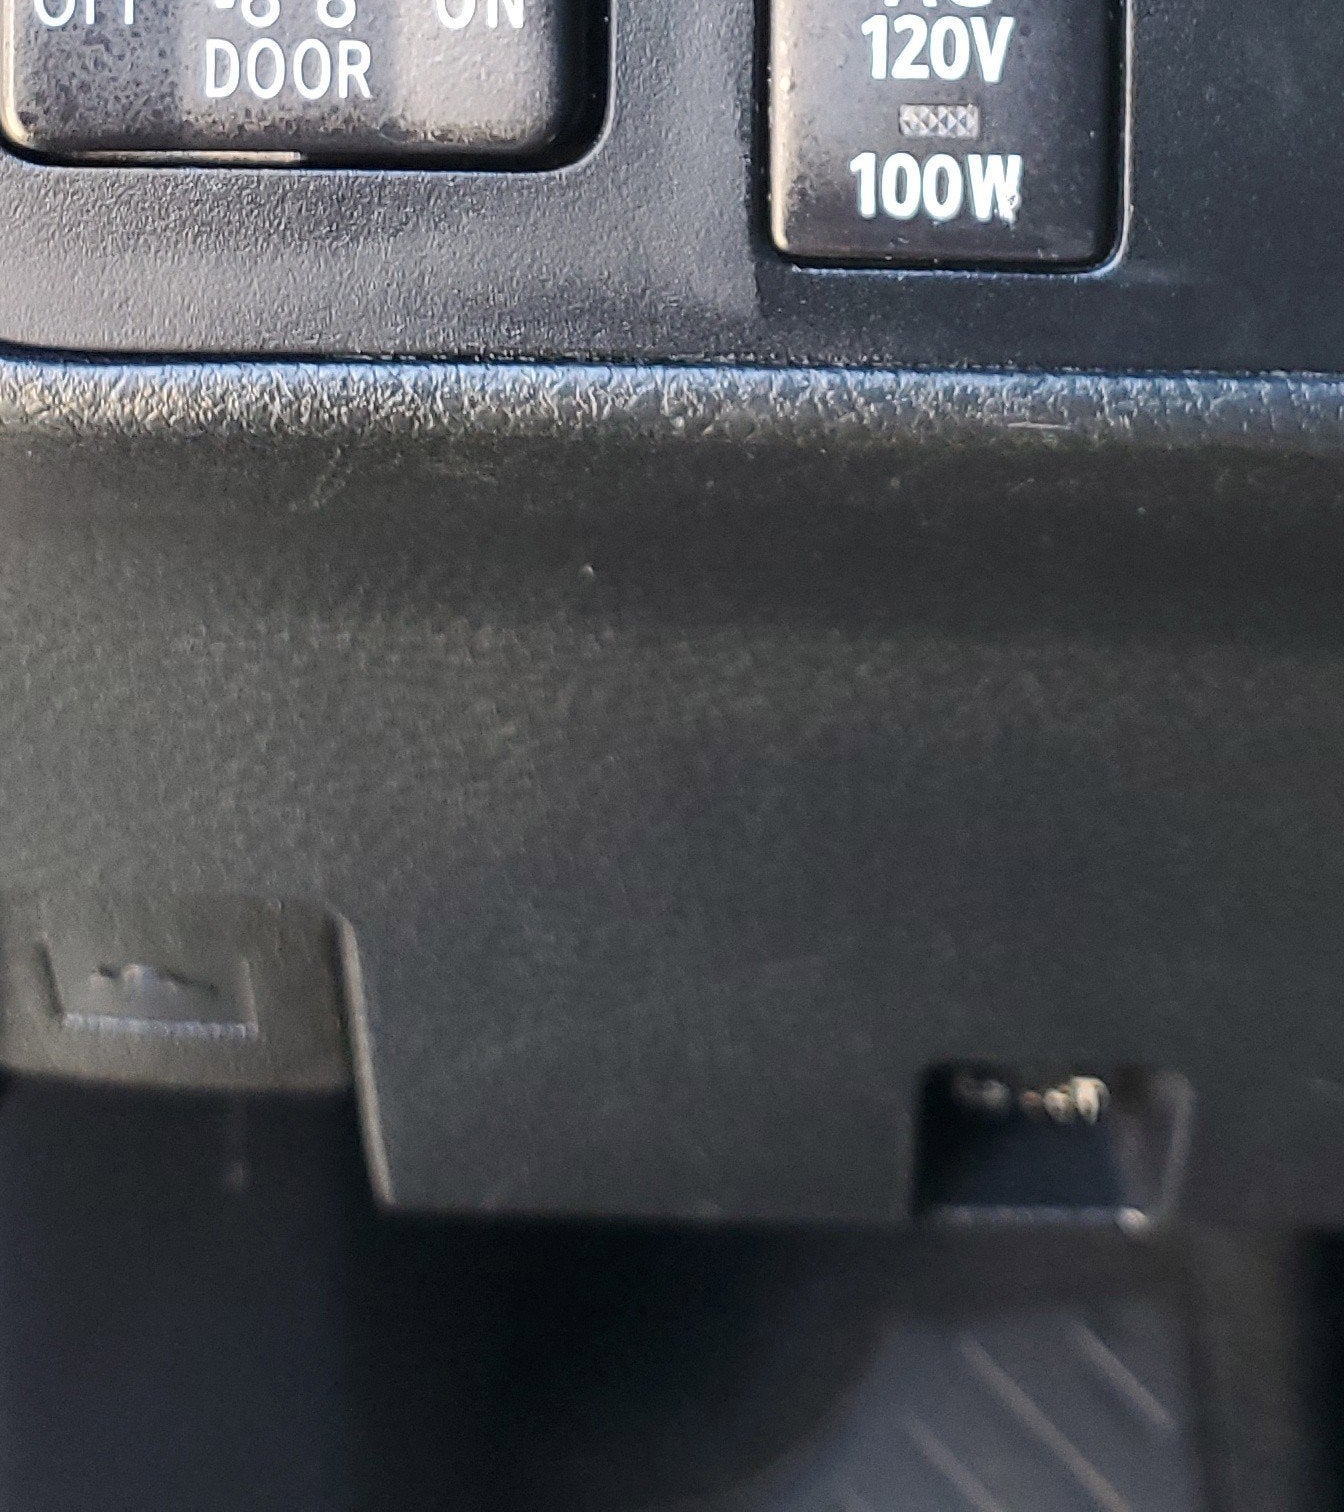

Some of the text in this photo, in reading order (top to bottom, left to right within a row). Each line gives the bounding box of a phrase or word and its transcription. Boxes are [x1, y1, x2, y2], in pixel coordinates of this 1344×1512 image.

[202, 36, 372, 102] DOOR
[859, 13, 1016, 84] 120V
[848, 151, 1024, 225] 100W
